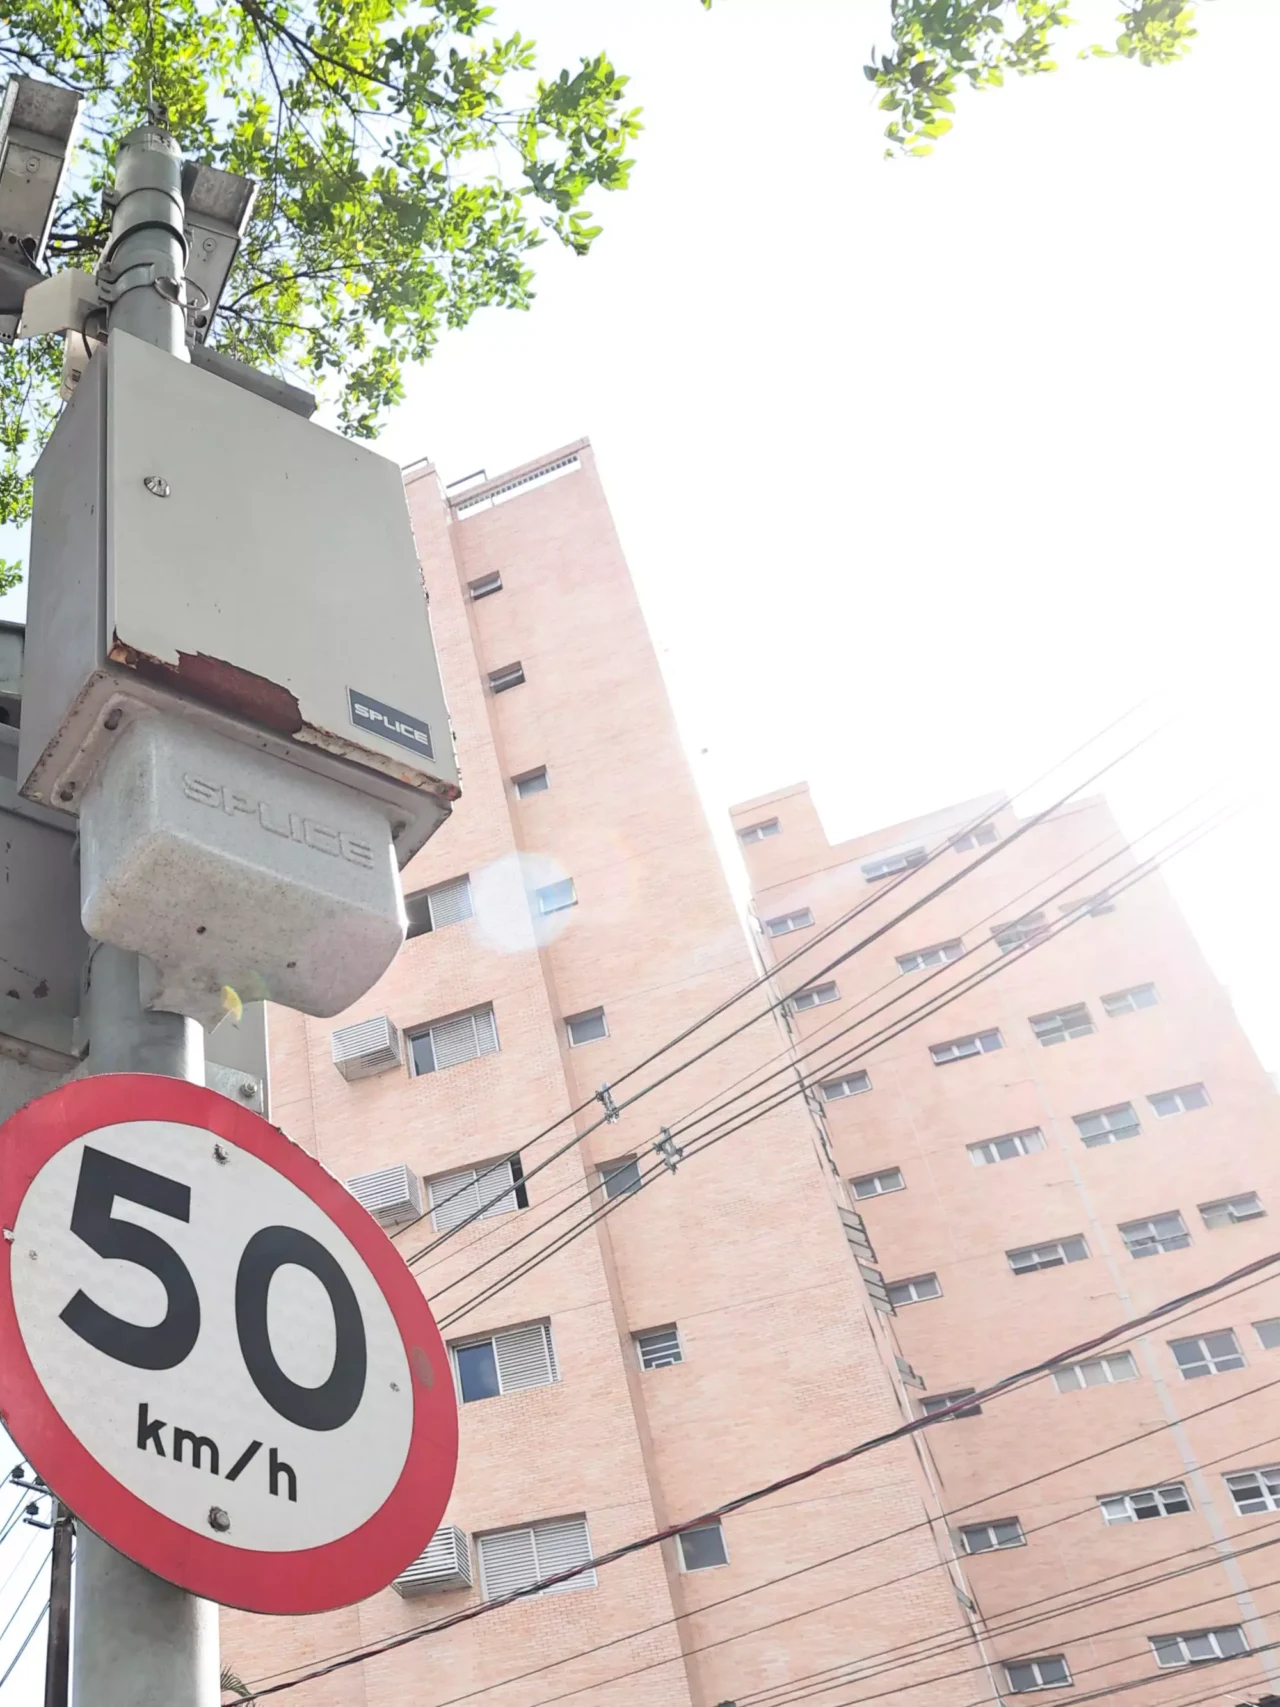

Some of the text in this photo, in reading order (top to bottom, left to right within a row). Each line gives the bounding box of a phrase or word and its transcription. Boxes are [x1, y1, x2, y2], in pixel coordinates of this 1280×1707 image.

[354, 703, 429, 746] SPLICE
[182, 773, 374, 870] SPLICE
[59, 1145, 367, 1432] 50
[137, 1402, 297, 1503] km/h
